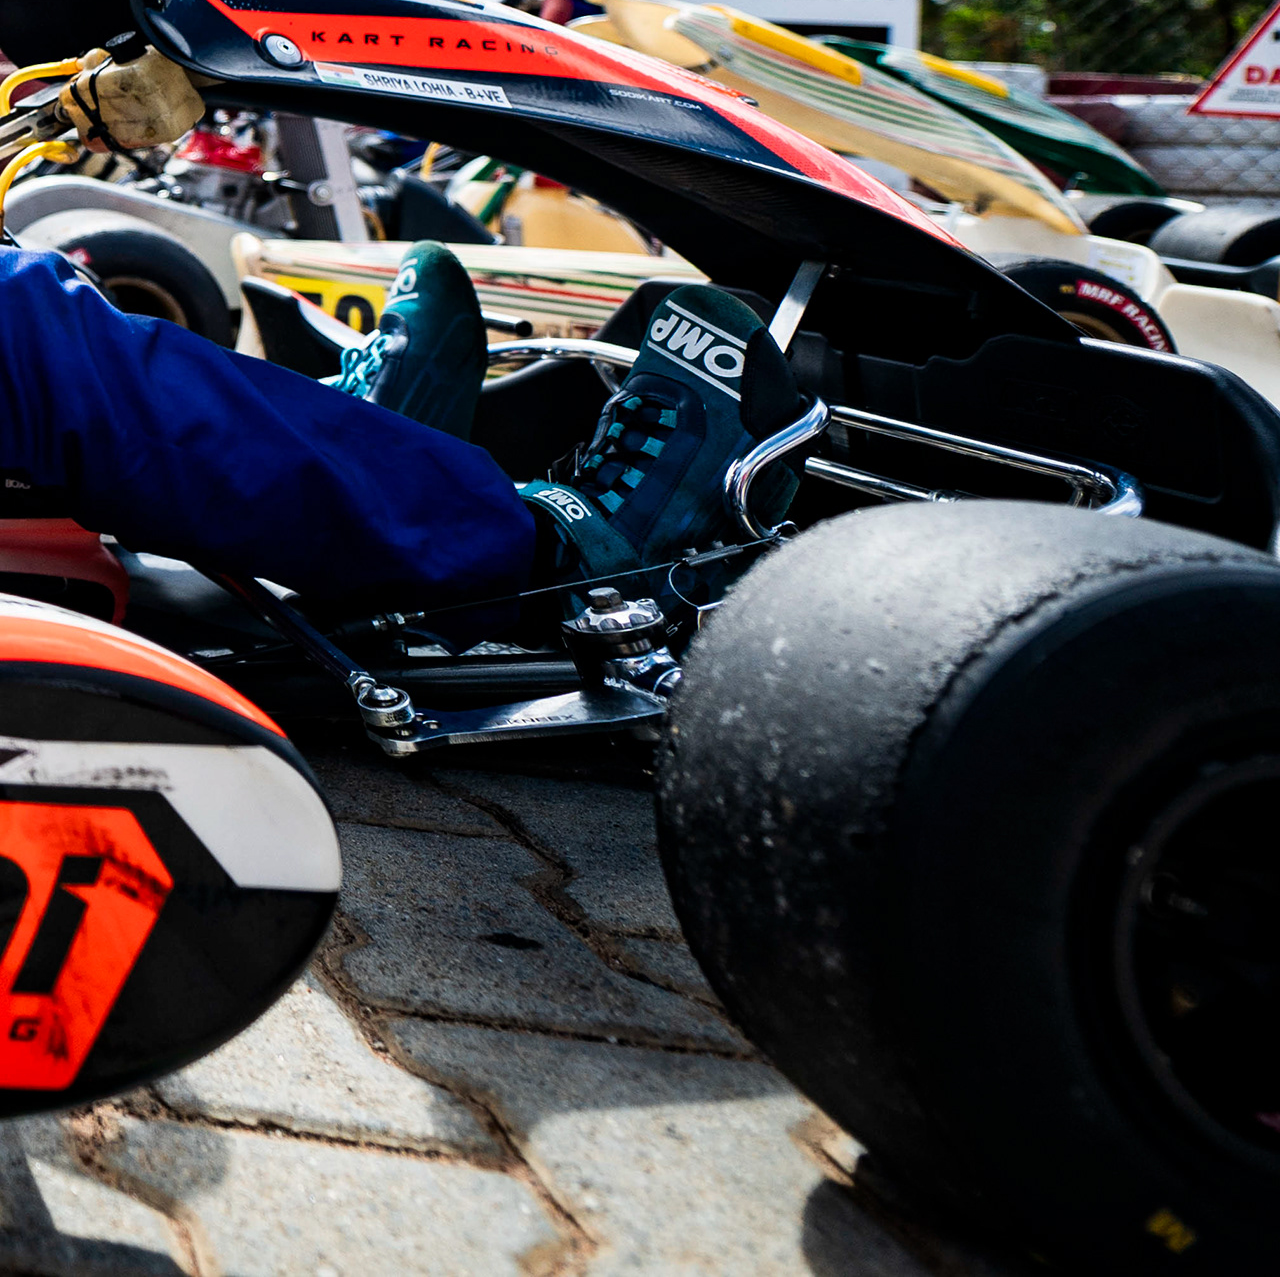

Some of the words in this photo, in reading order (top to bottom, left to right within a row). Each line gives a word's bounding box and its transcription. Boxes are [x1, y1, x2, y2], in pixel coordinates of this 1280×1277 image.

[311, 31, 405, 45] KART
[429, 36, 559, 56] RACING
[362, 73, 411, 91] SHRIYA
[412, 79, 454, 99] LOHIA
[466, 86, 504, 104] B+VE
[1079, 282, 1126, 306] MRF
[650, 313, 746, 378] OMP
